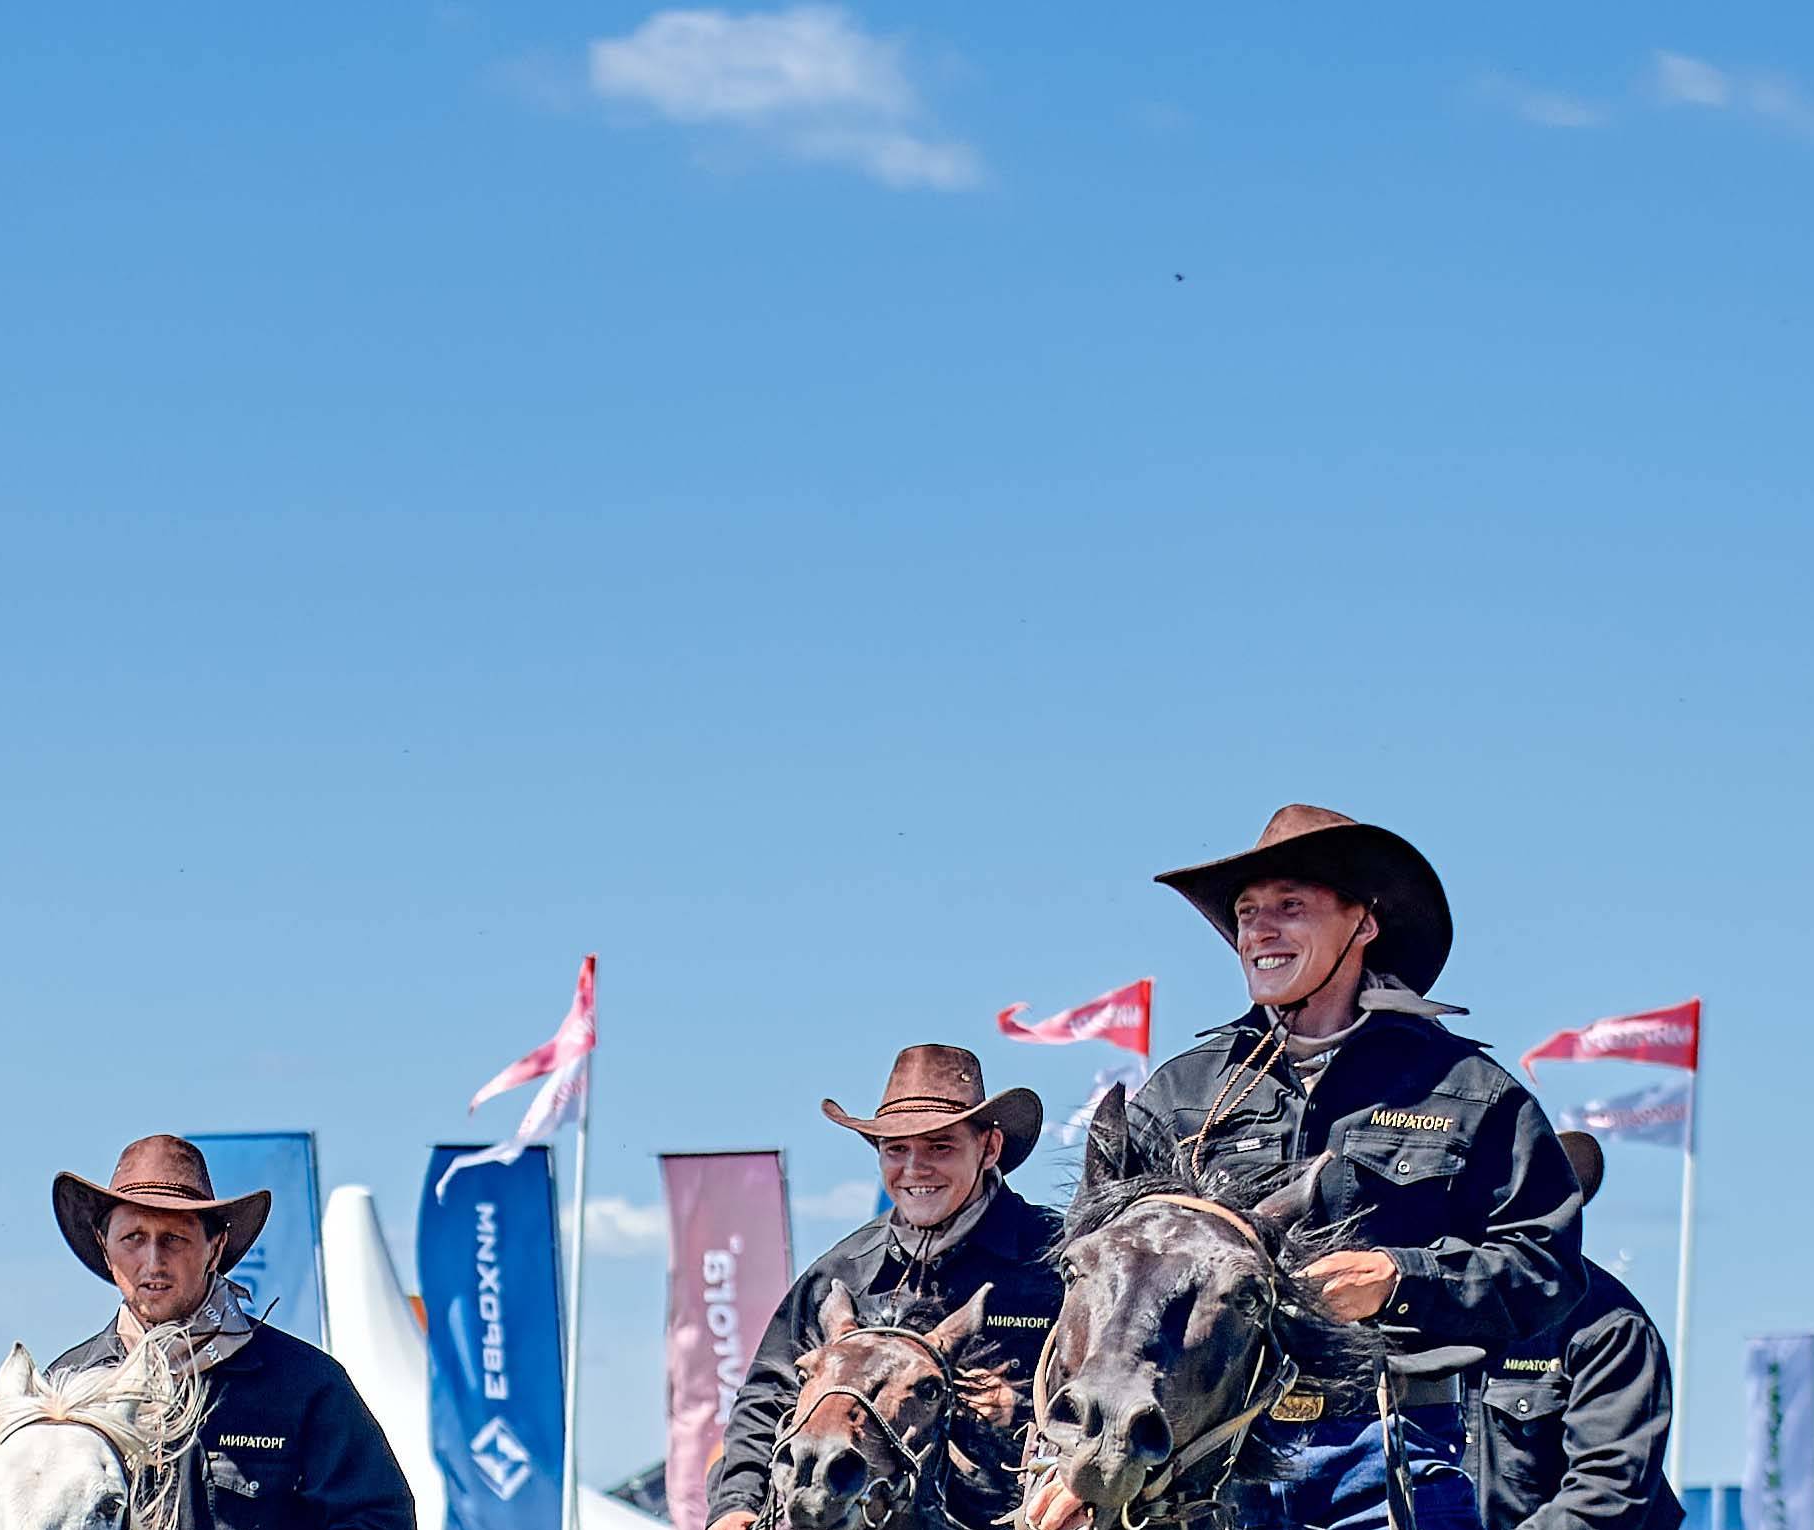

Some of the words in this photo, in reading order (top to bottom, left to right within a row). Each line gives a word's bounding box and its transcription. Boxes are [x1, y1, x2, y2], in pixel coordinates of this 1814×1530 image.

[1371, 1110, 1454, 1132] МИРАТОРГ
[987, 1315, 1050, 1329] МИРАТОРГ
[219, 1434, 286, 1449] МИРАТОРГ
